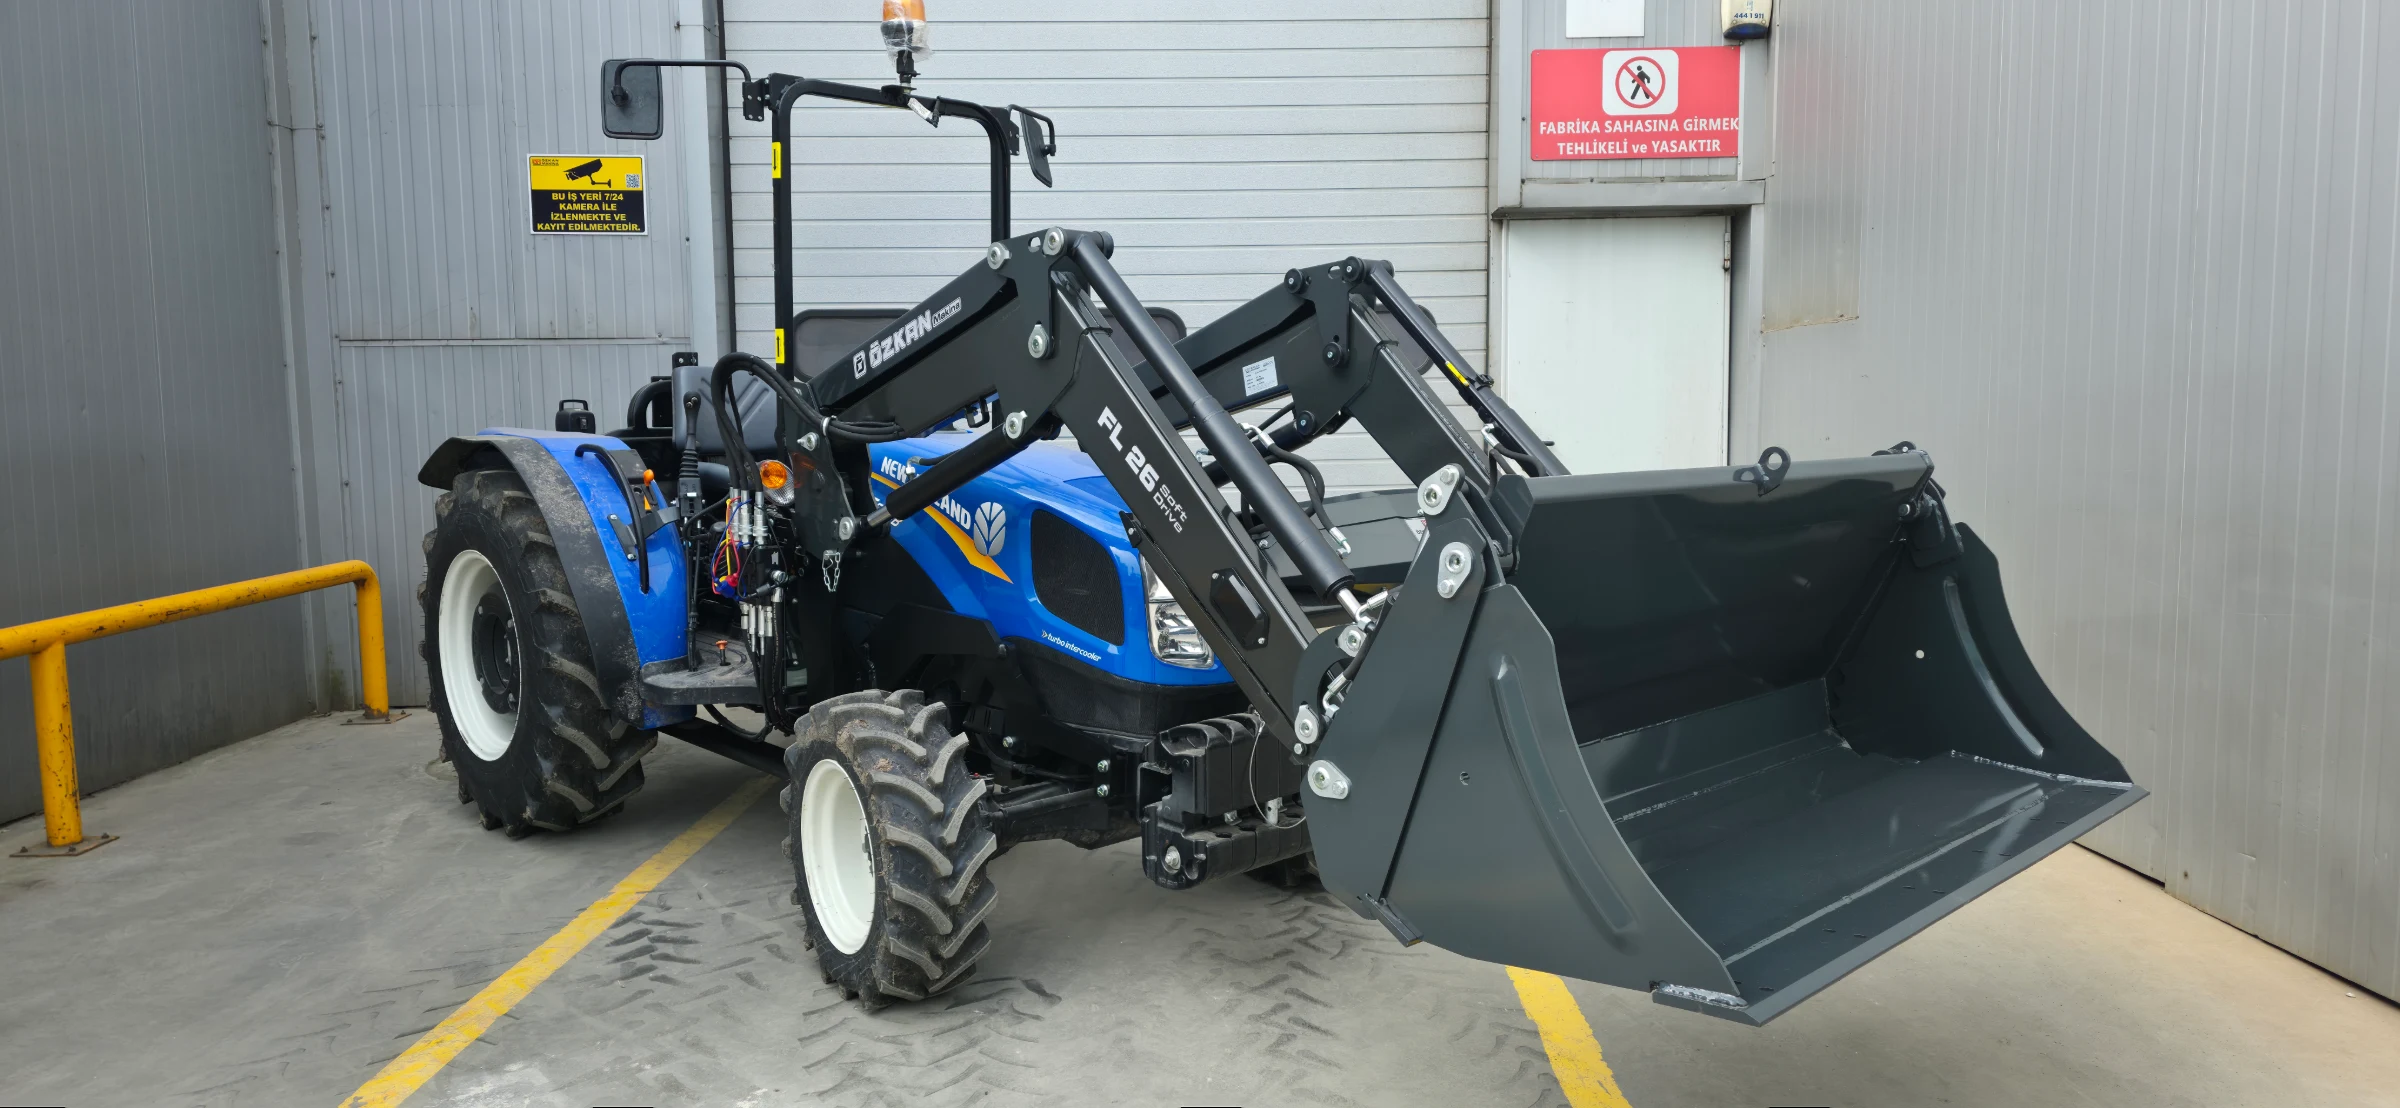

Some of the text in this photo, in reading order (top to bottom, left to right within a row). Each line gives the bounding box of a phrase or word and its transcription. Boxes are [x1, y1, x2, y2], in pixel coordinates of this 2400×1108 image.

[1540, 116, 1739, 135] FABRİKA SAHASINA GİRMEK
[1557, 138, 1721, 156] TEHLİKELİ ve YASAKTIR
[567, 191, 578, 202] İŞ
[579, 191, 602, 201] YERİ
[559, 201, 617, 211] KAMERA İLE
[550, 211, 627, 221] İZLENMEKTE VE
[537, 221, 641, 231] KAYIT EDİLMEKTEDİR.
[869, 309, 933, 369] ÖZKAN
[1097, 405, 1160, 492] FL 26
[880, 456, 908, 484] NEW
[1153, 491, 1183, 533] Drive
[1159, 484, 1188, 522] Soft
[1048, 633, 1065, 646] turbo
